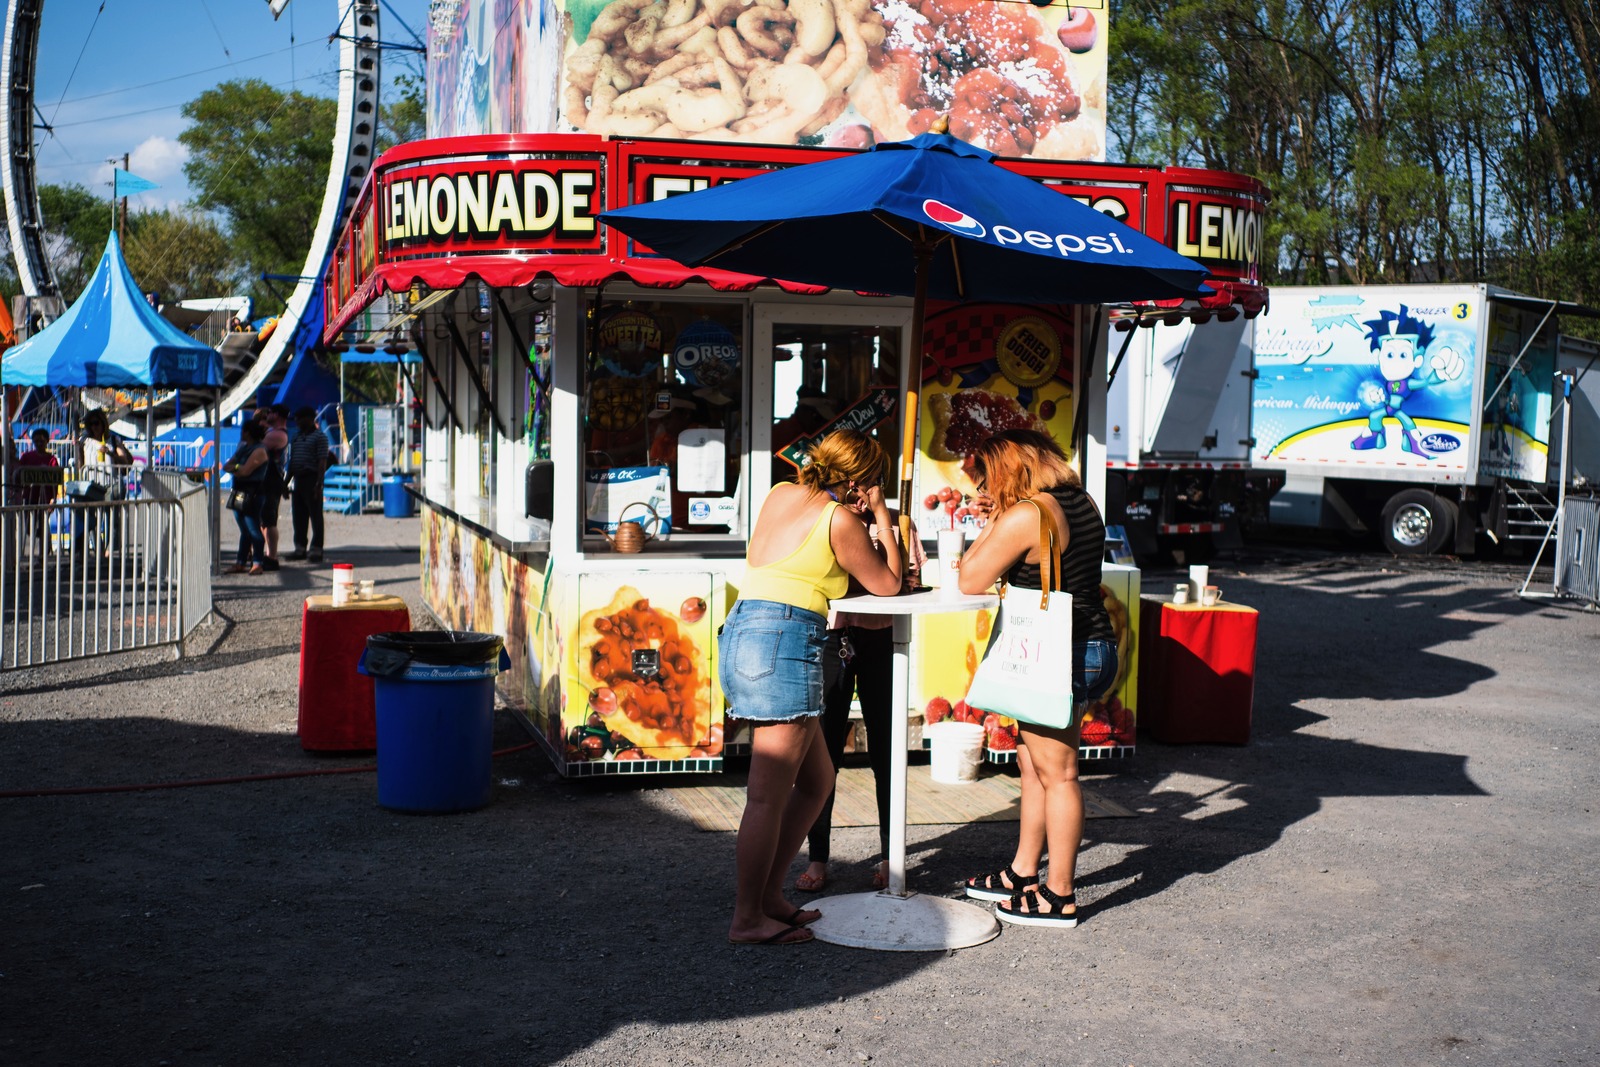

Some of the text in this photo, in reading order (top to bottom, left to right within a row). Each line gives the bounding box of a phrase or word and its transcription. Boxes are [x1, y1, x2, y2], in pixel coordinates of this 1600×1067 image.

[385, 171, 594, 241] LEMONADE
[1456, 303, 1468, 319] 3
[640, 327, 661, 348] TEA
[1018, 328, 1050, 361] FRIED
[1006, 337, 1046, 375] DOUGH
[848, 403, 876, 426] Dew
[600, 472, 616, 480] BIG
